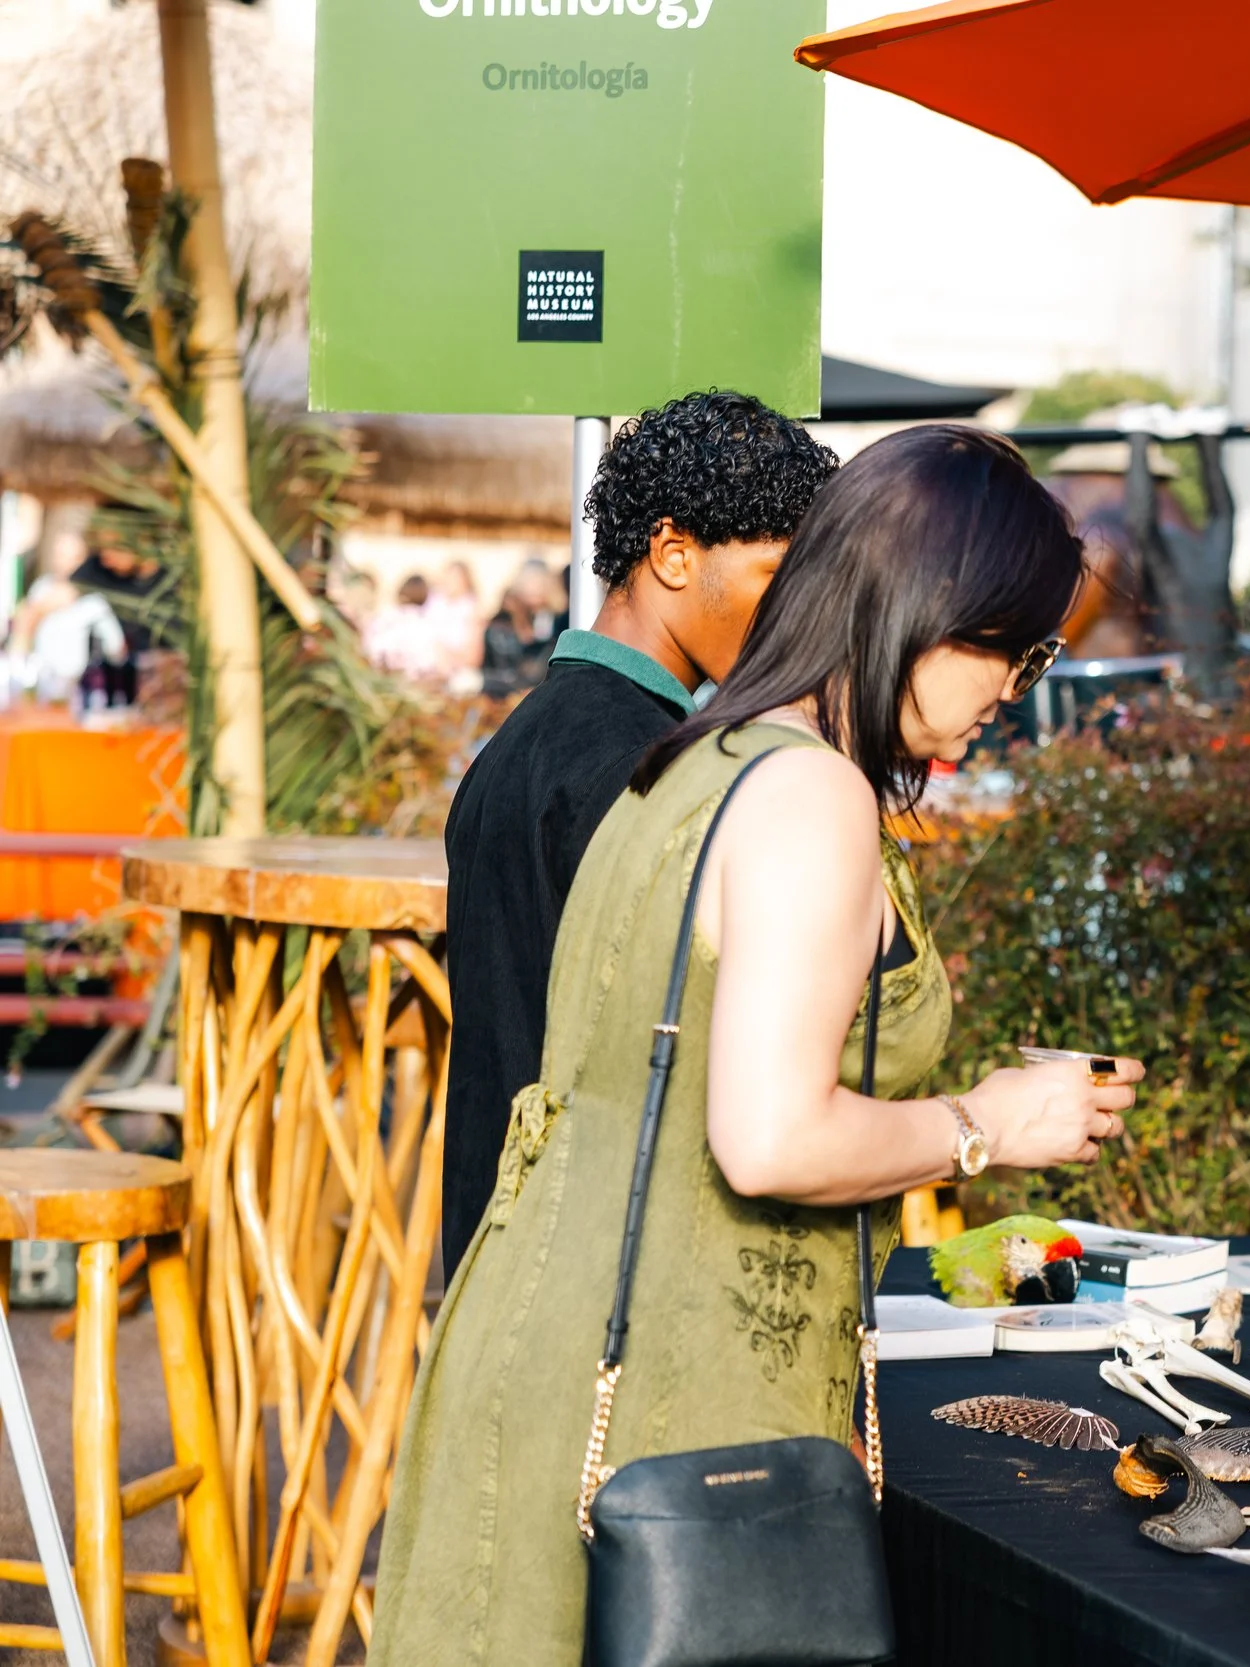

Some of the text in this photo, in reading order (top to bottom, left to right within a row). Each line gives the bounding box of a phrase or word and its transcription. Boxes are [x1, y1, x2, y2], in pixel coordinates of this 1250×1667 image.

[482, 60, 649, 99] Ornitología
[527, 270, 595, 283] NATURAL
[527, 284, 595, 297] HISTORY
[526, 298, 594, 311] MUSEUM
